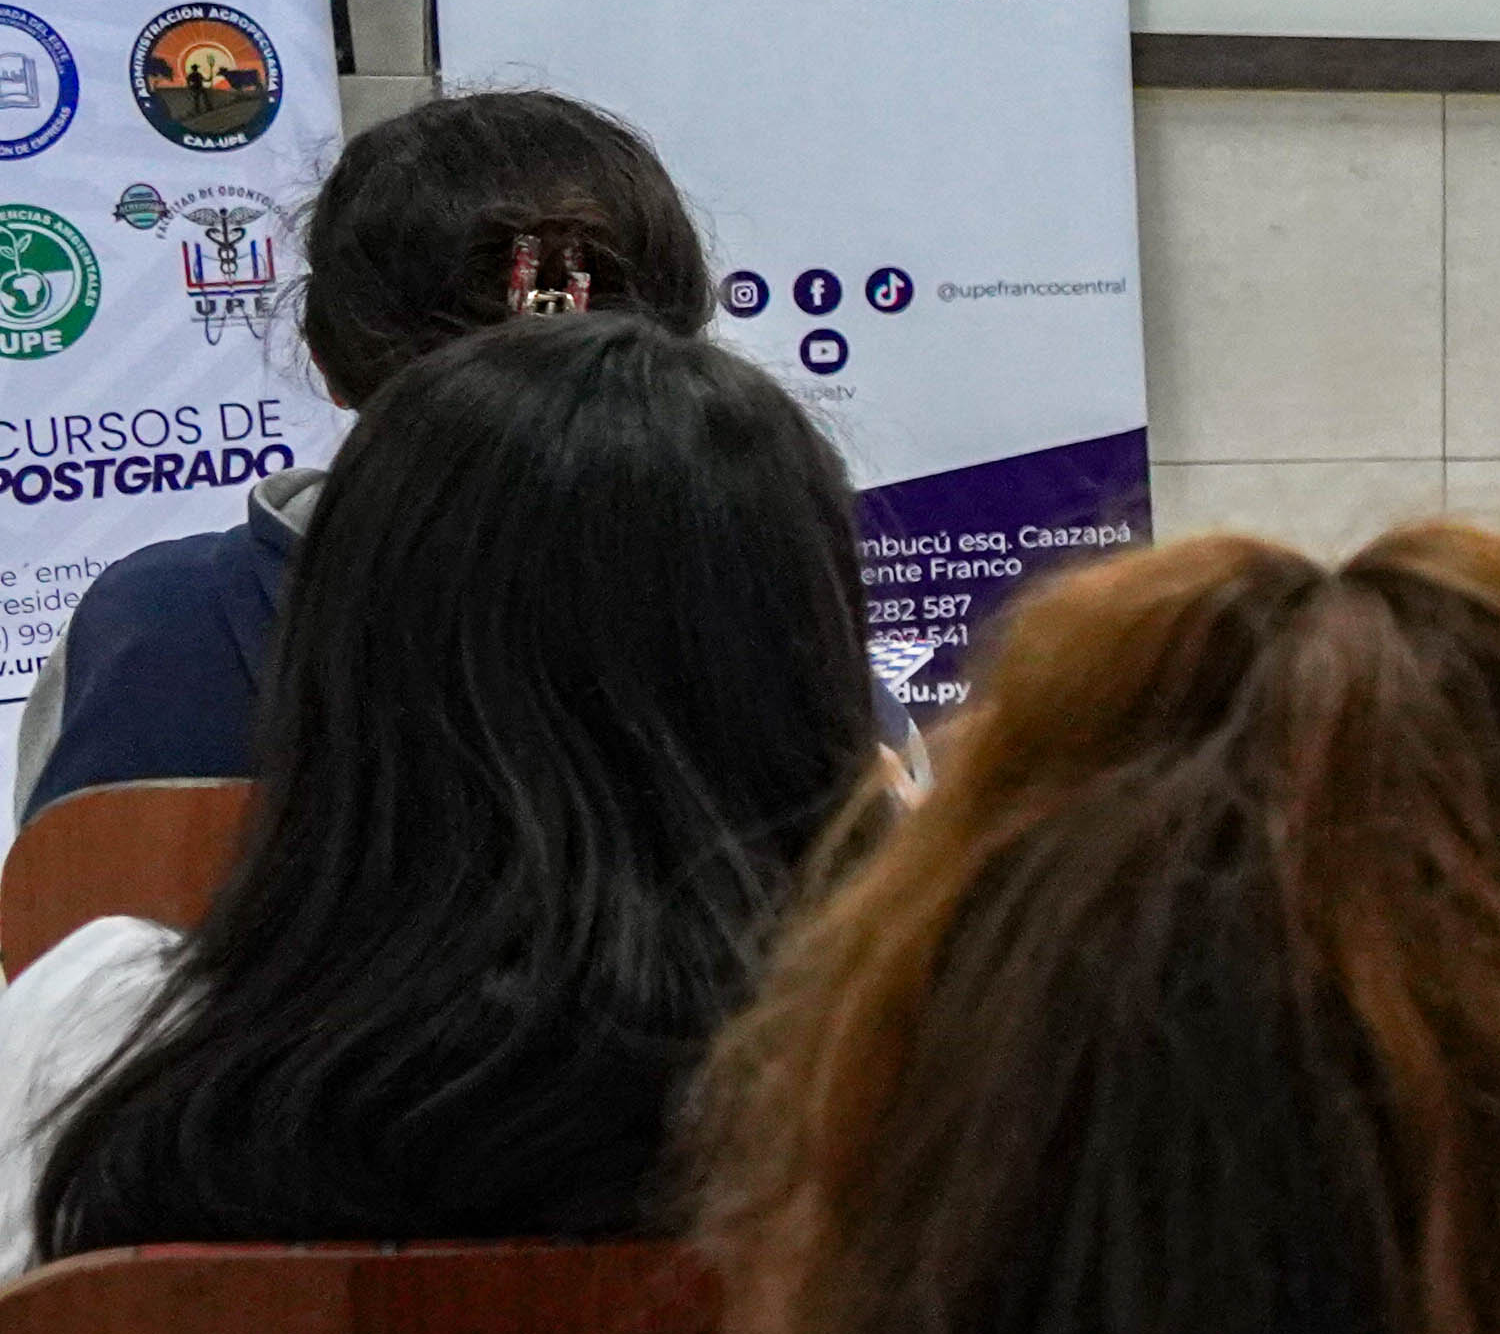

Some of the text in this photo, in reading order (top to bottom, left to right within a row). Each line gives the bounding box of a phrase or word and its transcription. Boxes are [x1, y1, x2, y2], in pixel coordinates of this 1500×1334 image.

[198, 187, 215, 200] DE
[937, 277, 1128, 304] @upefrancocentral
[0, 399, 283, 462] CURSOS DE
[958, 531, 1013, 555] esq.
[1019, 521, 1131, 549] Caazapá
[930, 557, 1022, 581] Franco
[923, 594, 972, 620] 587
